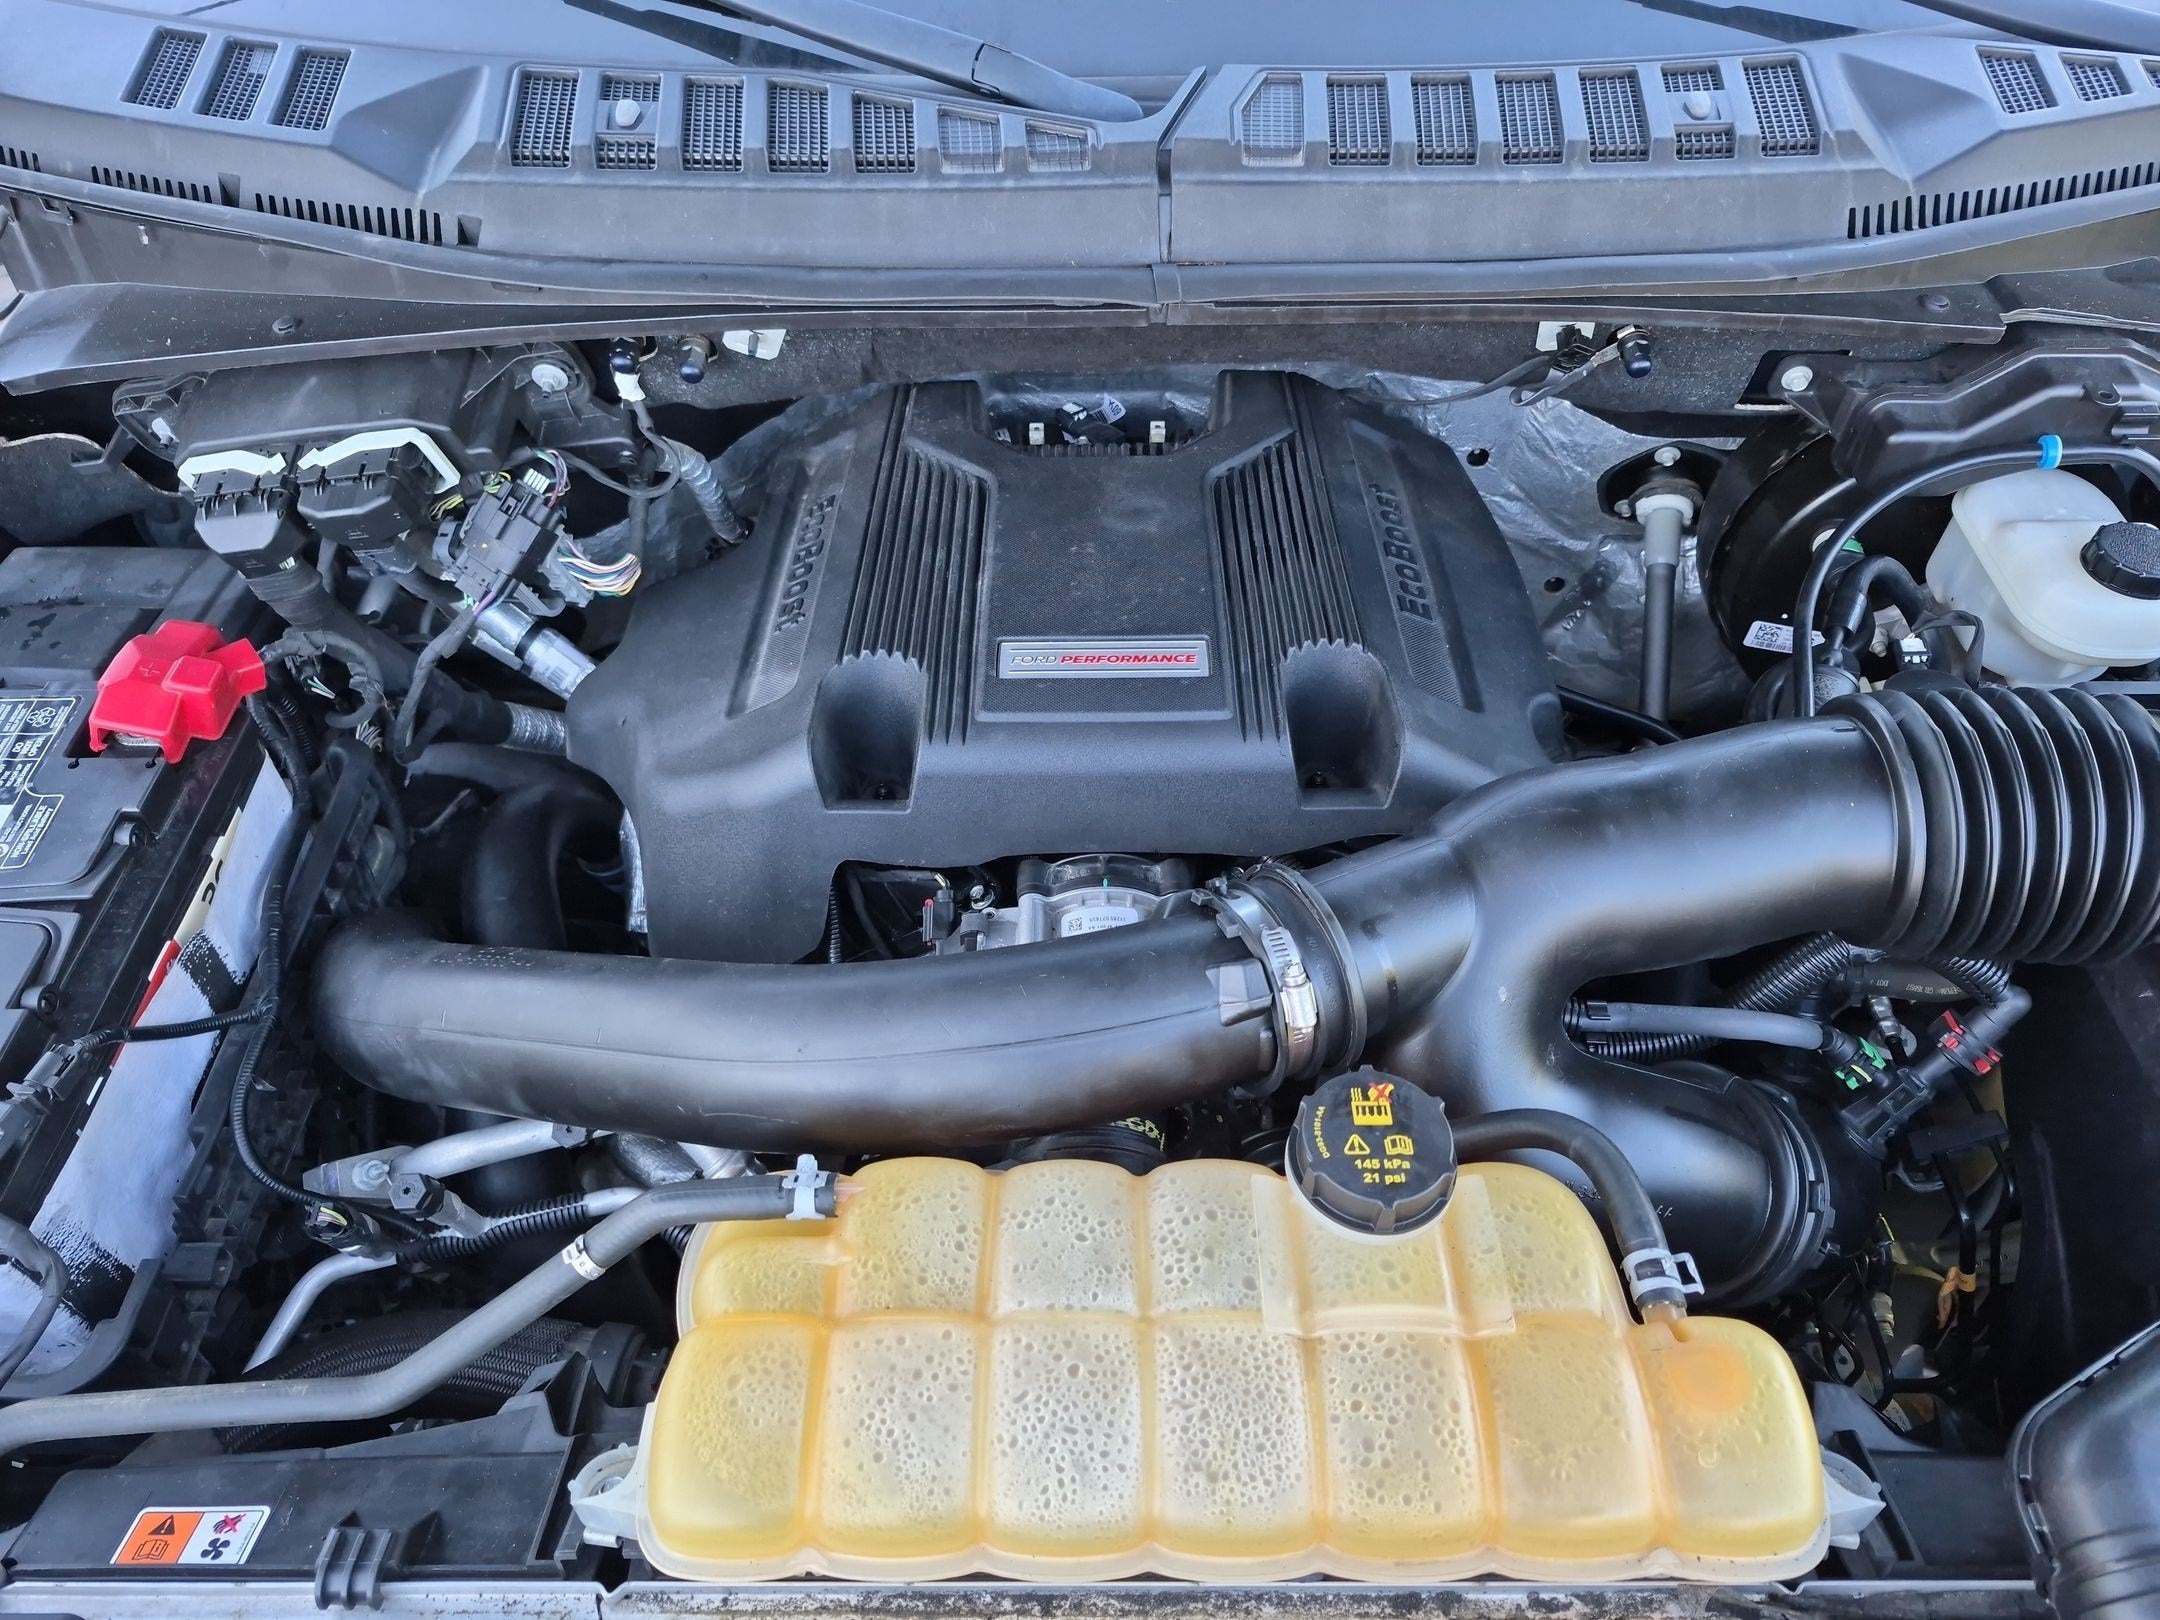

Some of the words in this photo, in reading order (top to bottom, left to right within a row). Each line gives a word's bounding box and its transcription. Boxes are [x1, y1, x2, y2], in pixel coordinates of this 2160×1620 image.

[1368, 483, 1434, 622] EcoBoost
[774, 494, 837, 632] EcoBoost
[1010, 656, 1057, 666] FORD
[1060, 654, 1197, 665] PERFORMANCE
[12, 742, 24, 752] DO
[10, 805, 47, 858] NON-SPILLABLE
[1354, 1159, 1380, 1169] 145
[1384, 1159, 1411, 1169] kPa
[1363, 1173, 1379, 1183] 21
[1385, 1173, 1406, 1185] psi
